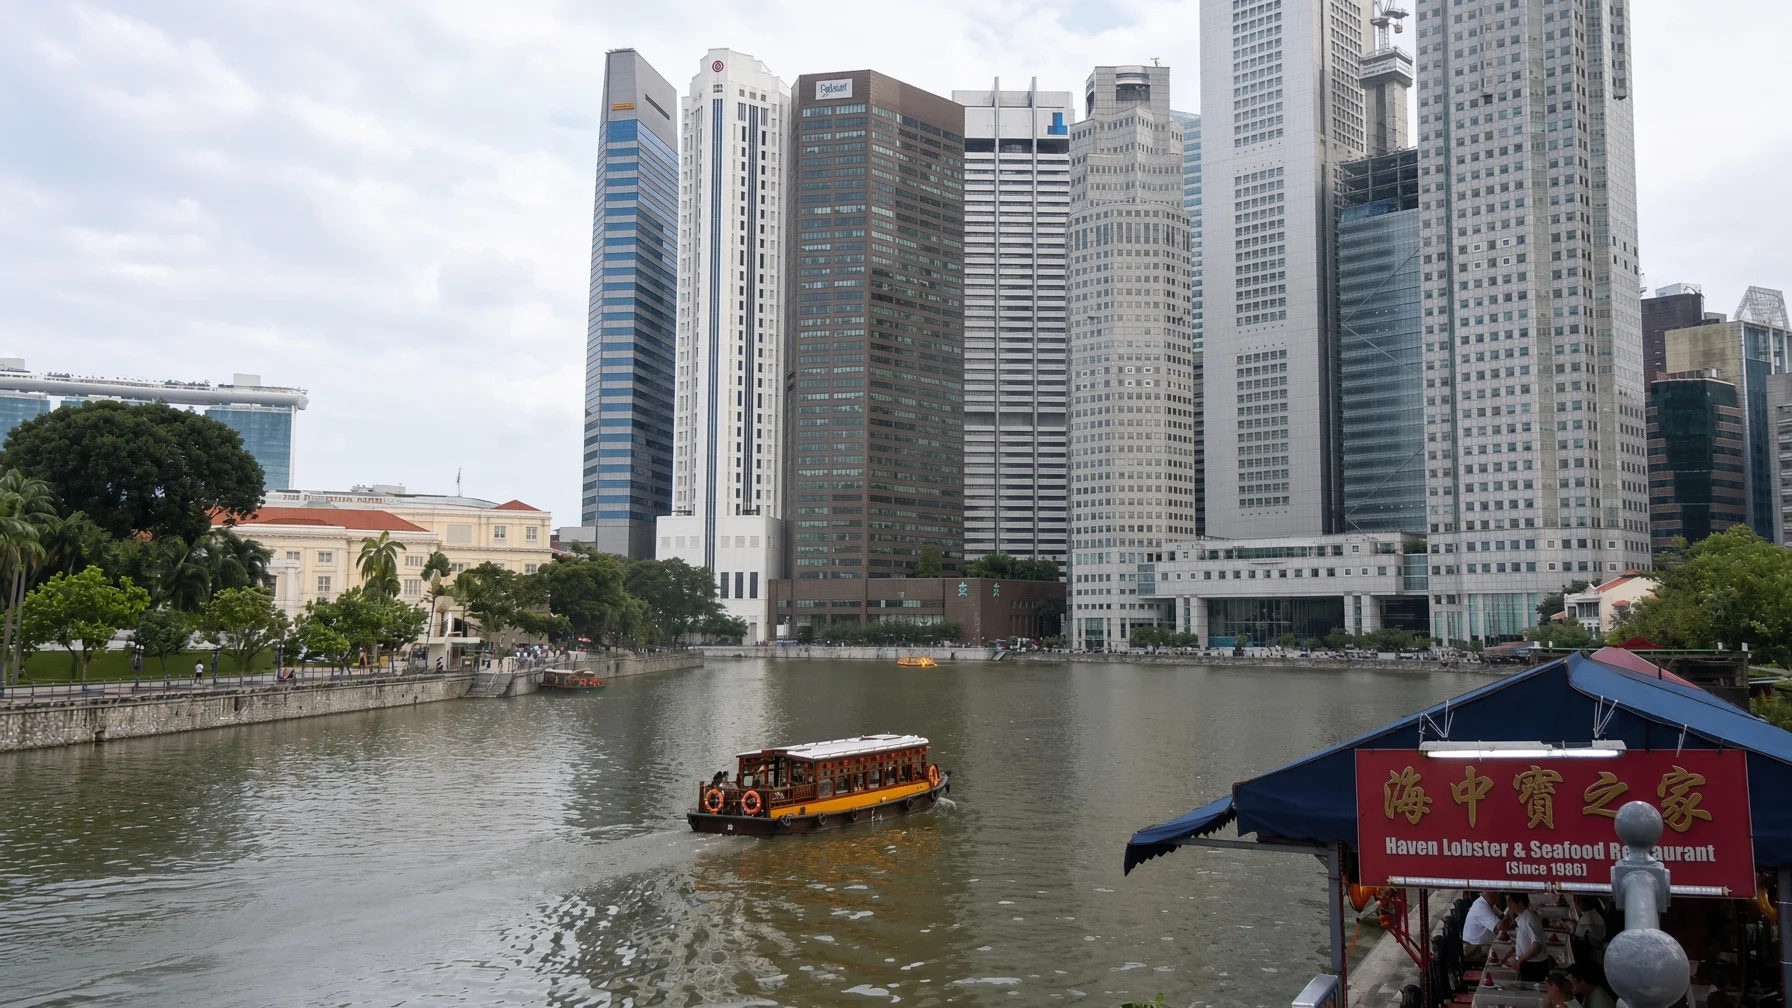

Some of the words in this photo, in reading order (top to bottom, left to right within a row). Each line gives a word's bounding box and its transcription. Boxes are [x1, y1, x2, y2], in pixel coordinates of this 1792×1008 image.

[1385, 837, 1438, 856] Haven
[1442, 838, 1508, 858] Lobster
[1513, 842, 1526, 858] &
[1530, 840, 1605, 860] Seafood
[1609, 842, 1716, 863] Reaurant
